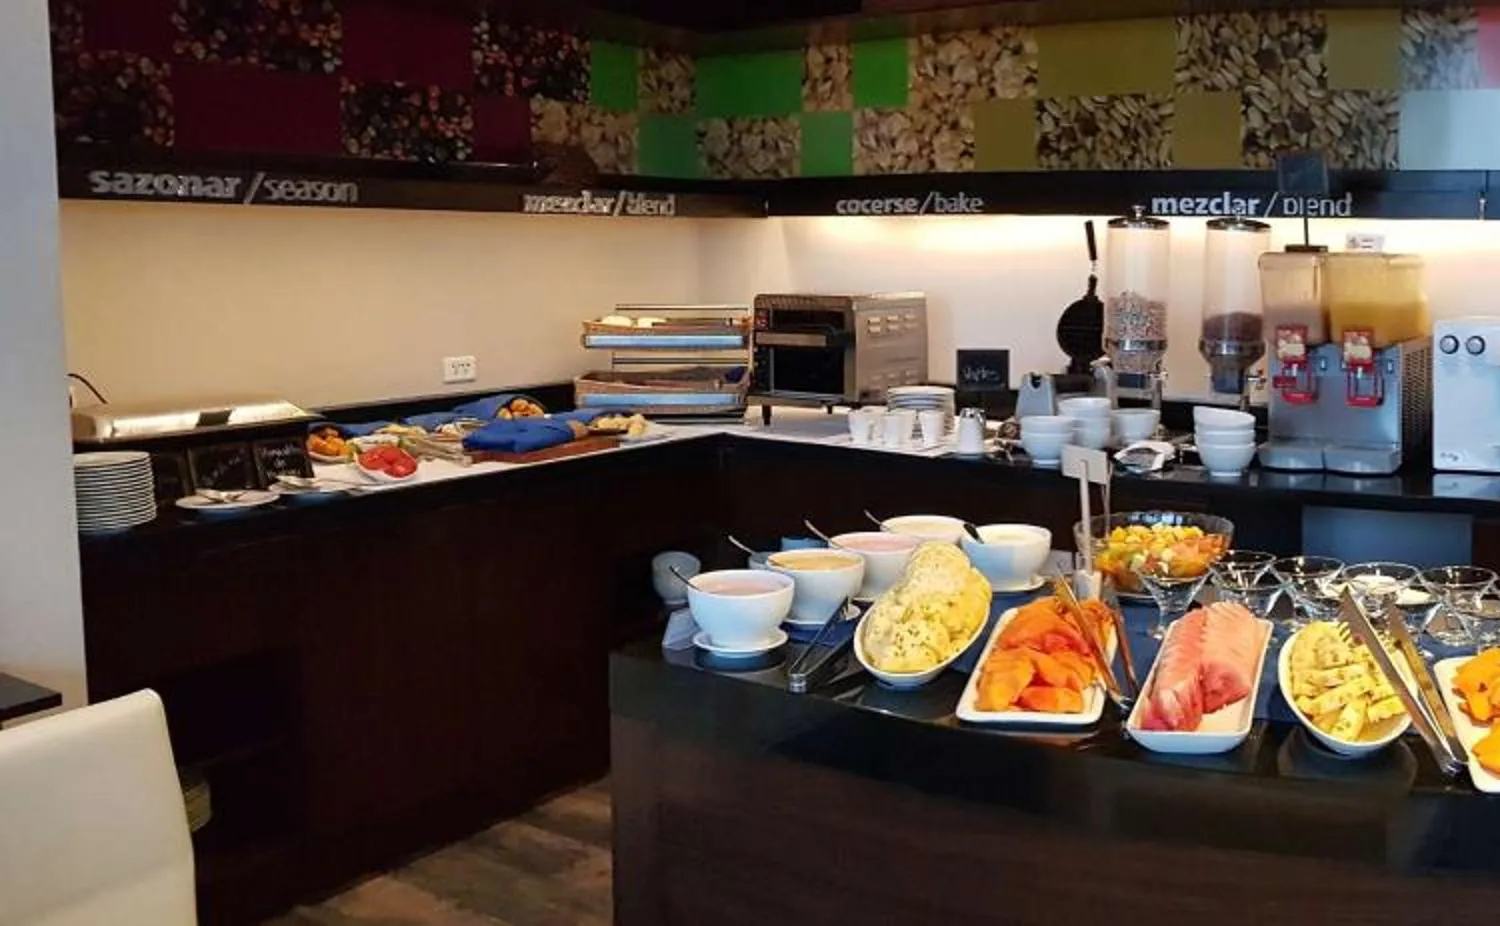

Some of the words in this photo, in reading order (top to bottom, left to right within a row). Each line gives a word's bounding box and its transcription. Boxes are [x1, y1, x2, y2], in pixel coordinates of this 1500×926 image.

[88, 169, 241, 199] sazonar
[835, 196, 918, 214] cocerse
[1151, 190, 1261, 216] mezclar
